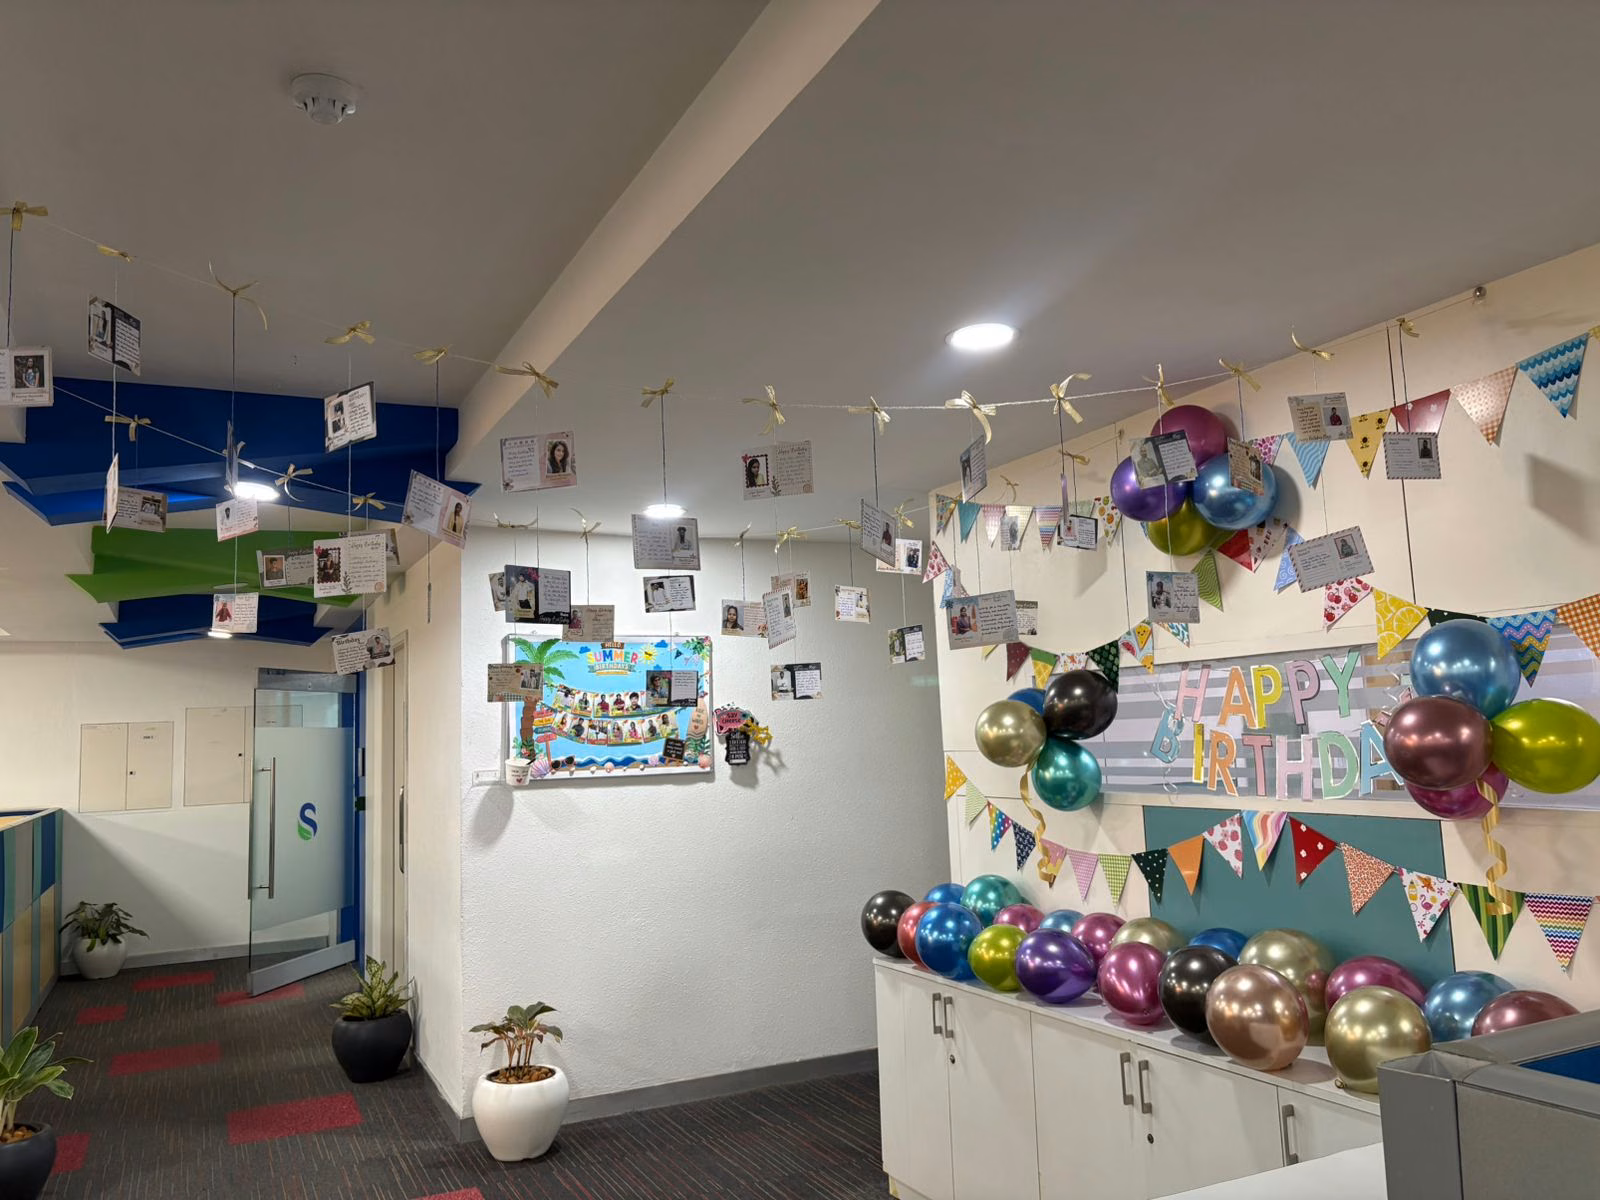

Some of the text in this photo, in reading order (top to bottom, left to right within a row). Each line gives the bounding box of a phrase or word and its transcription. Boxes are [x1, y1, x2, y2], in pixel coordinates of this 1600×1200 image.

[587, 650, 639, 664] SUMMER
[1174, 651, 1361, 729] HAPPY
[1151, 706, 1408, 801] BIRTHDA
